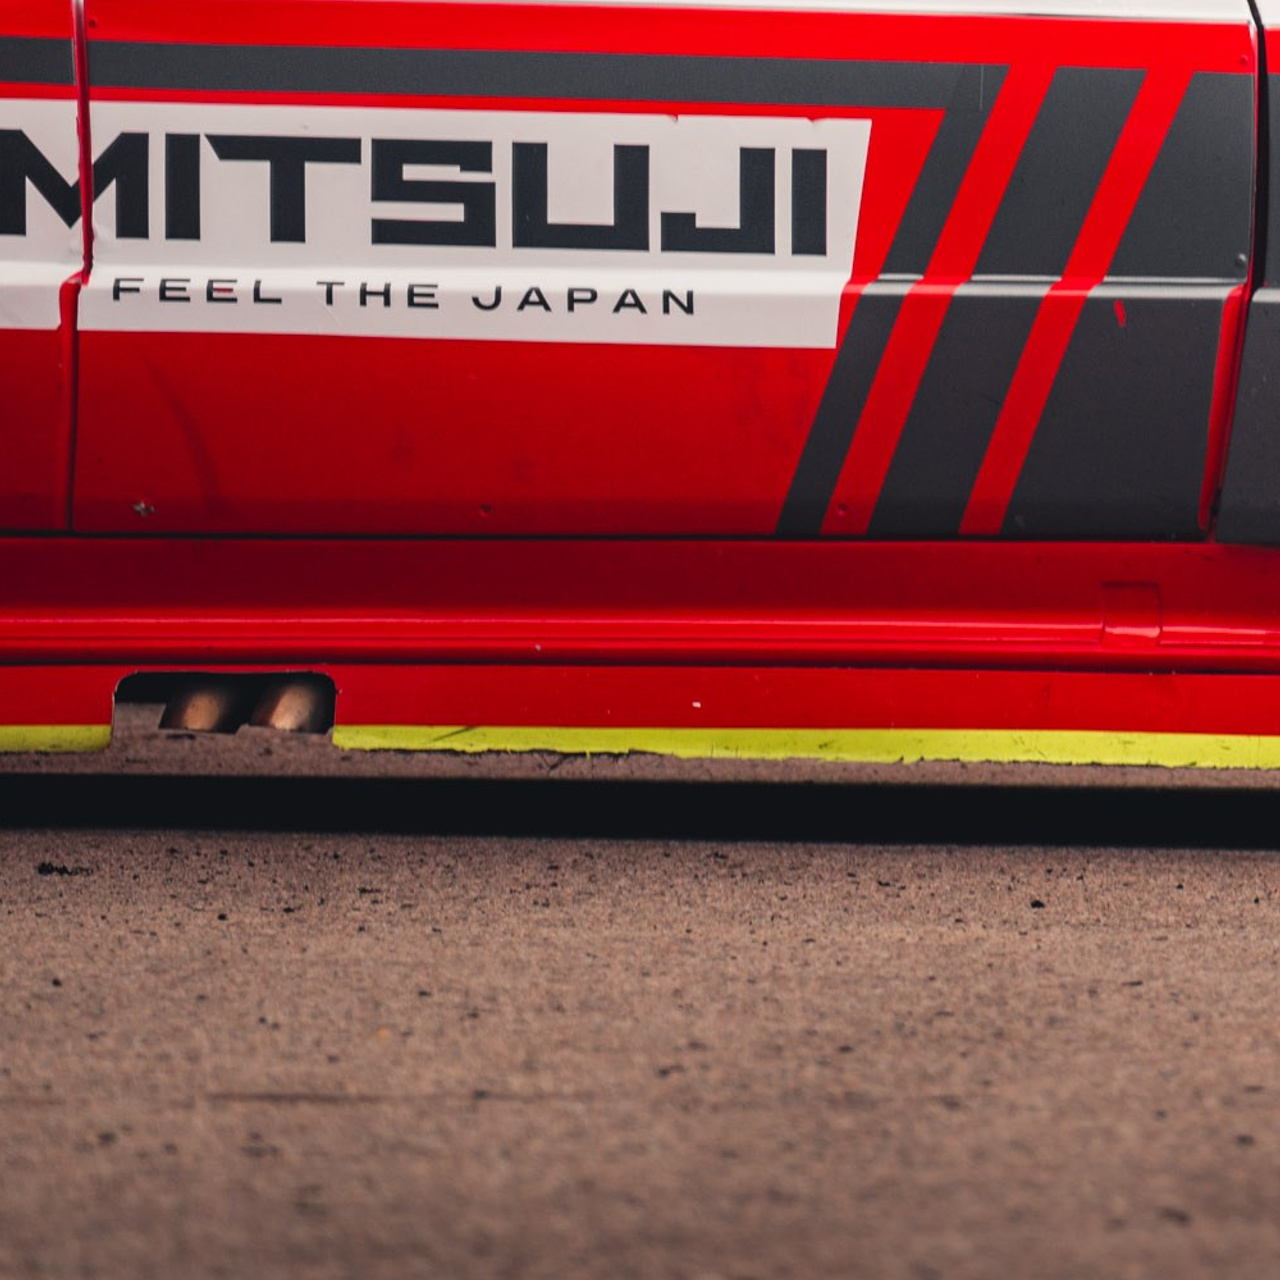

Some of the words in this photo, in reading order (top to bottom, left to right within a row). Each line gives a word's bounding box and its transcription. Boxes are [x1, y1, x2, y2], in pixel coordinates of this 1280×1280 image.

[0, 129, 828, 256] MITSUJI
[112, 277, 283, 304] FEEL
[316, 281, 439, 308] THE
[471, 286, 695, 315] JAPAN
